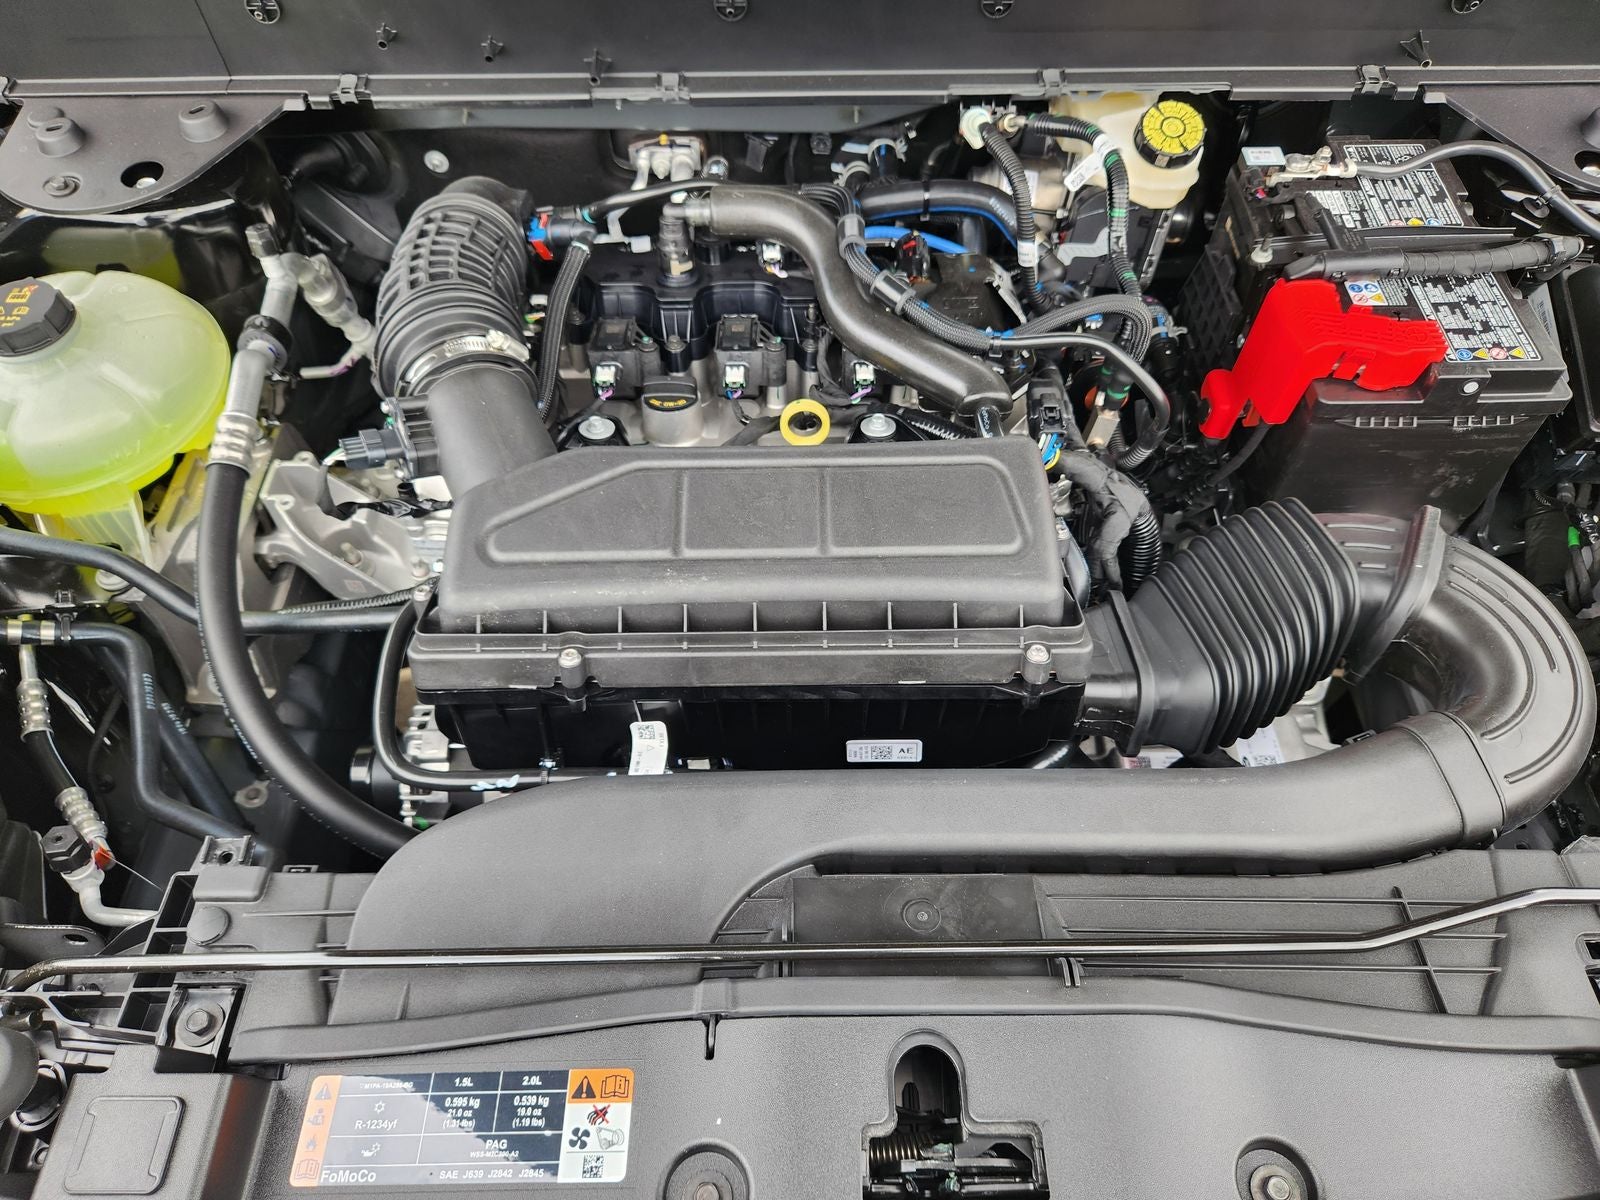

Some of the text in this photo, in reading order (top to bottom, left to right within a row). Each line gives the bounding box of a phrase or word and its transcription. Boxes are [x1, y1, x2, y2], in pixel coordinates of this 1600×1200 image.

[454, 1077, 473, 1087] 1.5L
[522, 1076, 542, 1086] 2.0L
[445, 1097, 480, 1108] 0.595 kg
[514, 1095, 549, 1107] 0.539 kg
[447, 1109, 462, 1117] 21.0
[517, 1108, 542, 1116] 19.0 oz
[354, 1119, 398, 1131] R-1234yf
[512, 1117, 545, 1128] (1.19 lbs)
[485, 1139, 507, 1149] PAG
[320, 1169, 377, 1183] FoMoCo
[439, 1169, 545, 1179] SAE J639 J2842 J2845
